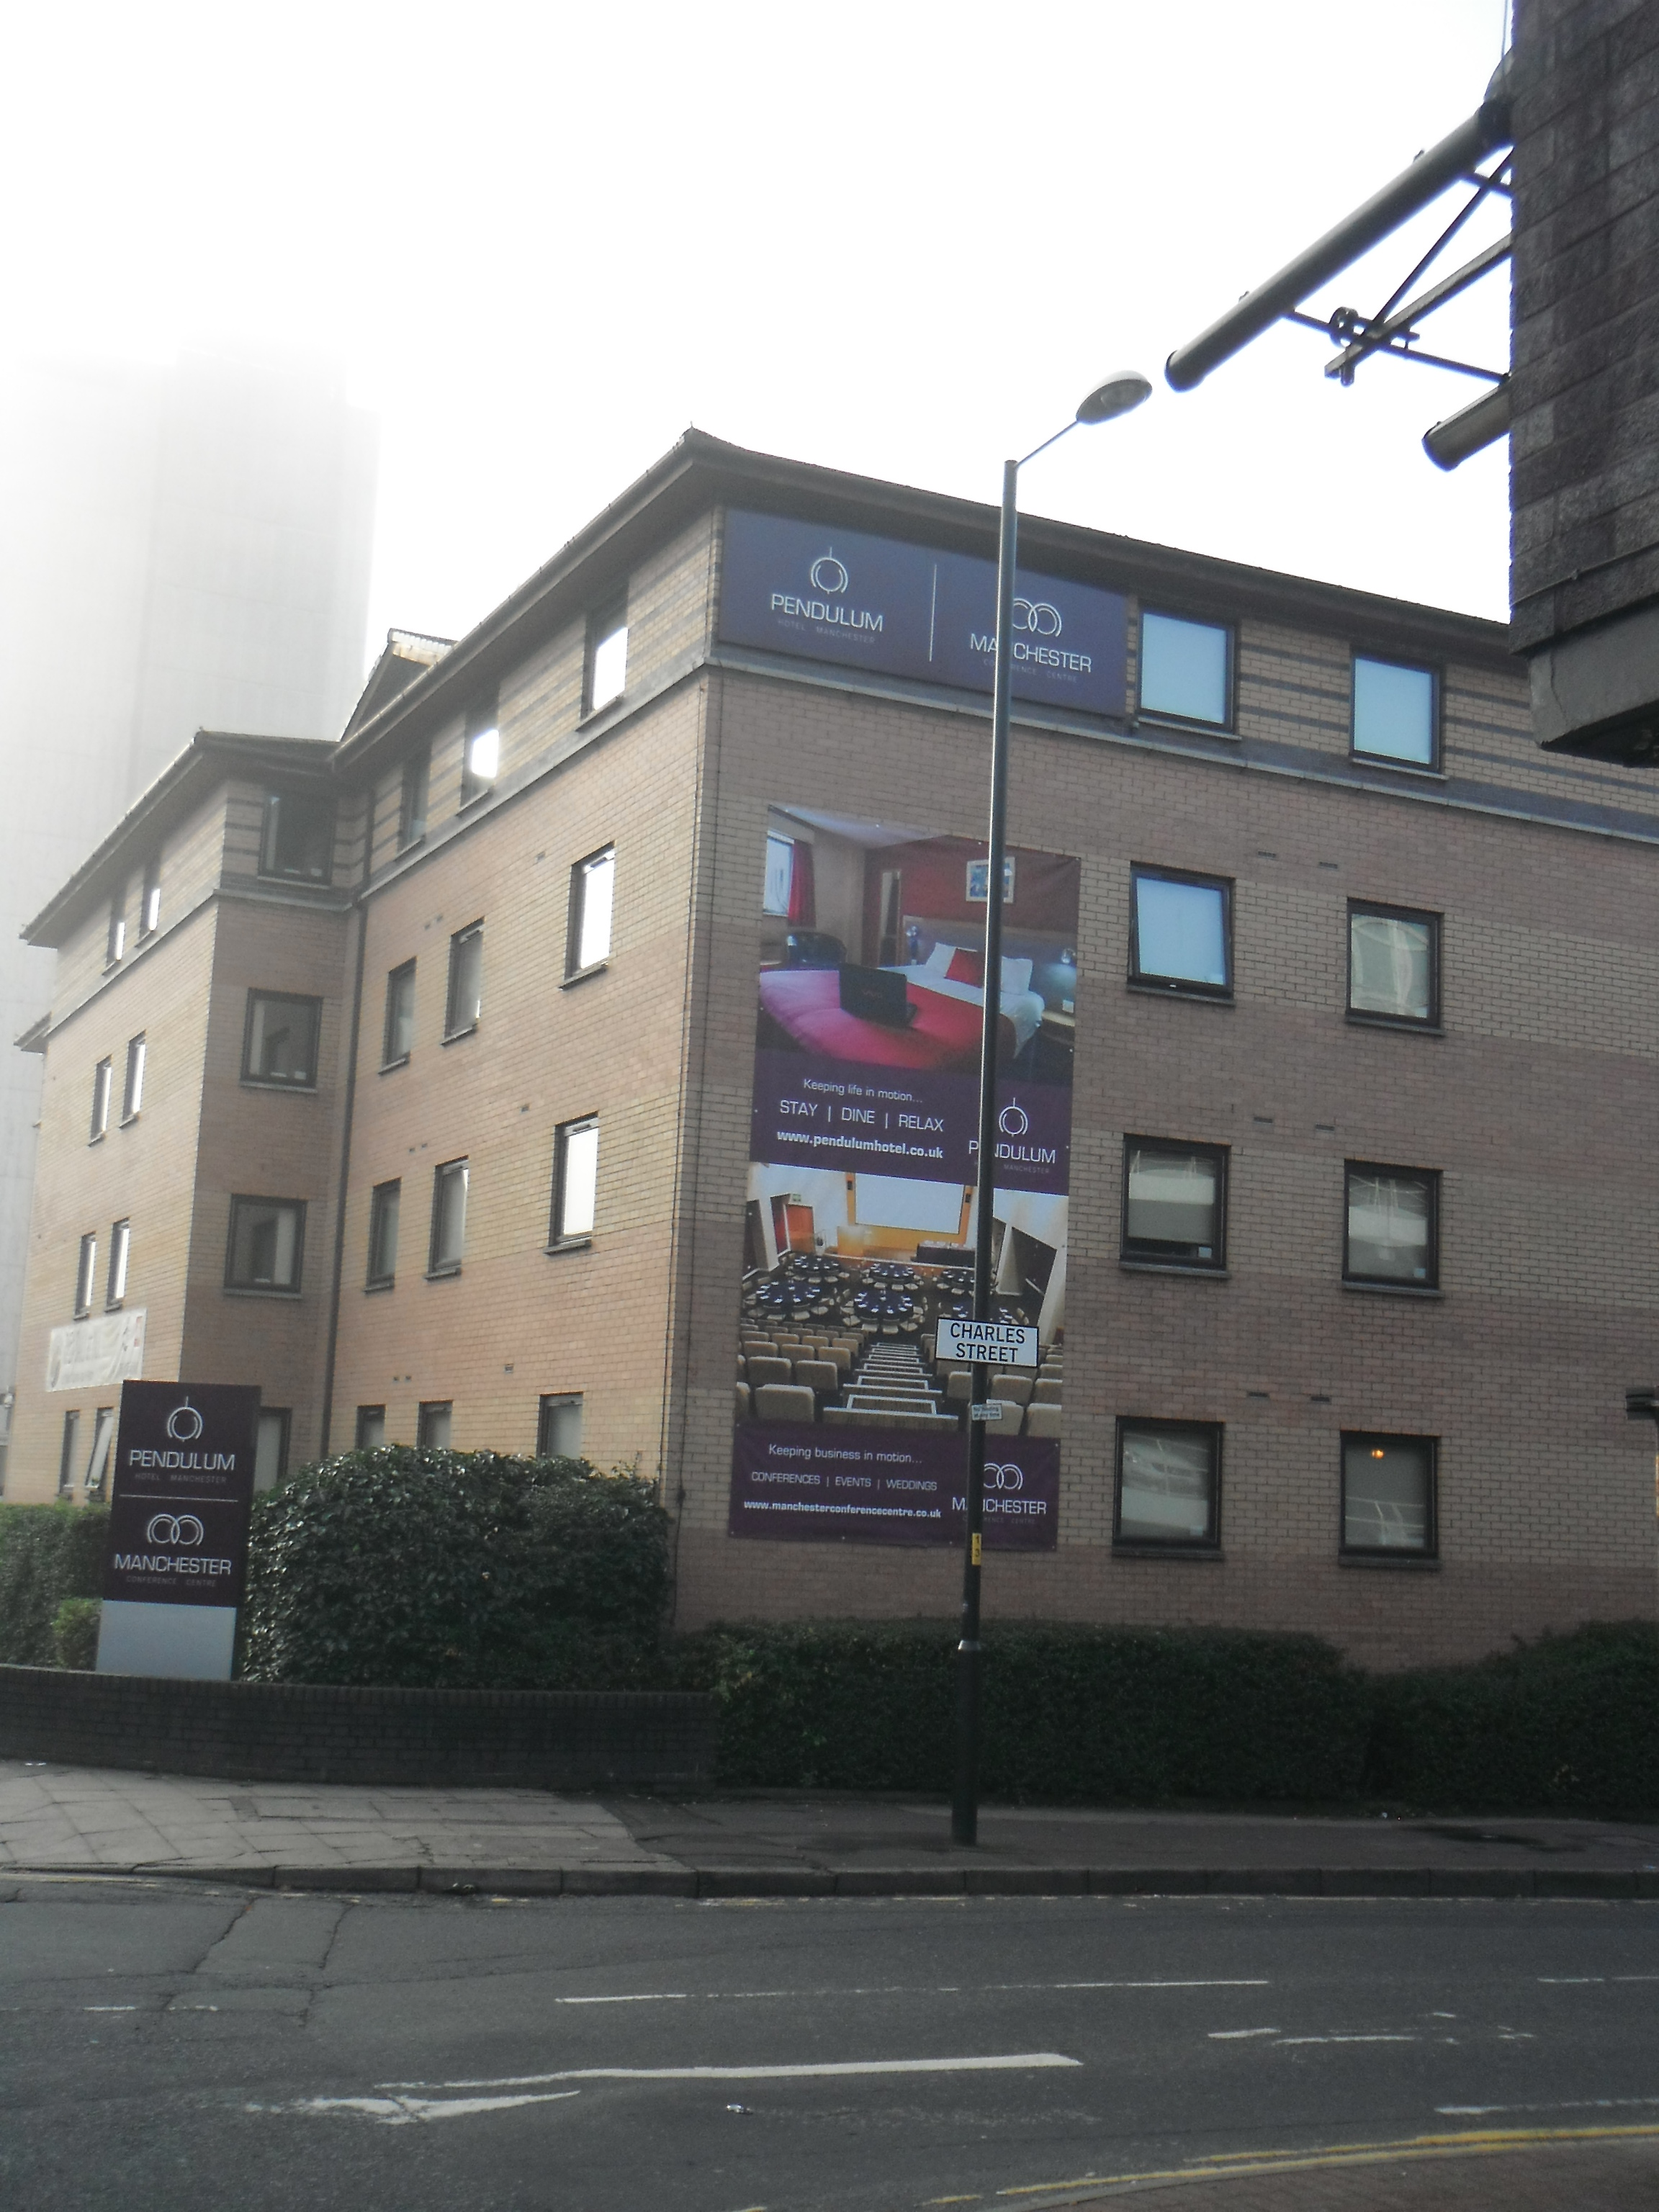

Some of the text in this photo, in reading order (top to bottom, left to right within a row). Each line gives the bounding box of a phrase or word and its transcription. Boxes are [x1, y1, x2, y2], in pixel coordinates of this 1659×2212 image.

[771, 593, 884, 632] PENDULUM
[816, 626, 876, 644] MANCHESTER
[970, 633, 1092, 673] MACHESTER
[804, 1079, 845, 1096] Keeping
[848, 1084, 863, 1096] life
[866, 1086, 875, 1097] in
[780, 1100, 944, 1132] STAY DINE RELAX
[777, 1131, 943, 1159] www.pendulumhotel.co.uk
[968, 1140, 1056, 1164] PDULUM
[950, 1322, 1025, 1344] CHARLES
[956, 1342, 1018, 1362] STREET
[129, 1449, 235, 1471] PENDULUM
[768, 1444, 811, 1460] Keeping
[815, 1447, 860, 1460] business
[864, 1449, 873, 1460] in
[170, 1475, 228, 1483] MANCHESTER
[751, 1471, 938, 1491] CONFERENCES EVENTS WEDDINGS
[744, 1501, 941, 1519] www.manchesterconferencecentre.co.uk
[114, 1554, 232, 1575] MANCHESTER
